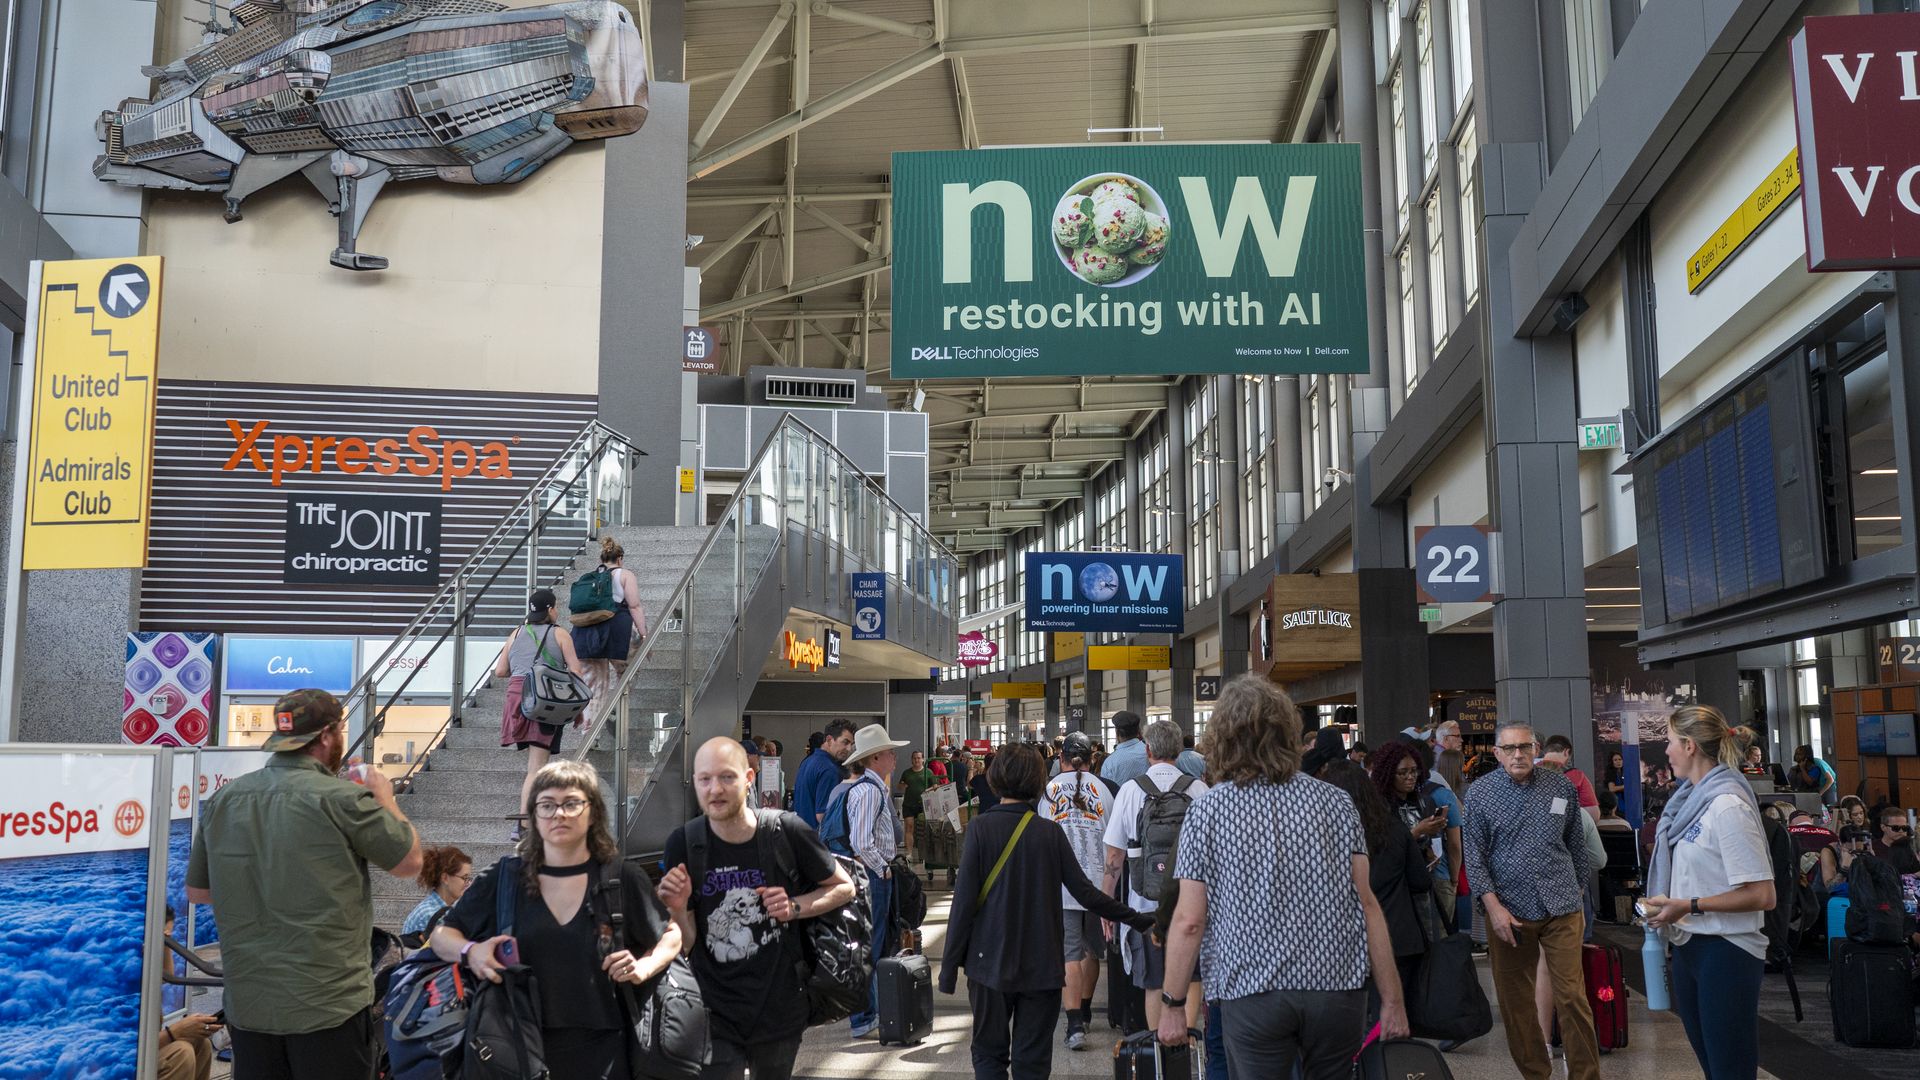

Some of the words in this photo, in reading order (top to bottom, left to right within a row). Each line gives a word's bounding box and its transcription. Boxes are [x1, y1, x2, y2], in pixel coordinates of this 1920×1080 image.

[1757, 188, 1774, 212] Gates
[1774, 177, 1782, 196] 23
[1785, 164, 1794, 184] 34
[1701, 249, 1715, 269] Gates
[1721, 233, 1728, 250] 22
[943, 293, 1163, 336] restocking
[1178, 291, 1264, 326] with
[1279, 292, 1321, 325] AI
[1235, 347, 1272, 356] Welcome
[1273, 347, 1282, 356] to
[1283, 347, 1302, 356] Now
[1315, 346, 1350, 356] Dell.com
[52, 372, 120, 399] United
[65, 406, 112, 432] Club
[1585, 424, 1617, 447] EXIT
[222, 419, 513, 491] XpresSpa
[39, 455, 131, 483] Admirals
[64, 490, 112, 516] Club
[296, 502, 337, 525] THE
[330, 509, 431, 551] JOINT
[291, 552, 428, 574] chiropractic
[1427, 545, 1480, 583] 22
[853, 590, 883, 598] MASSAGE
[859, 580, 878, 588] CHAIR
[1041, 603, 1090, 616] powering
[1092, 603, 1119, 614] lunar
[1121, 604, 1169, 615] missions
[1282, 610, 1317, 630] SALT
[1318, 610, 1352, 629] LICK
[388, 655, 429, 669] essie
[788, 631, 824, 672] XpresSpa
[1880, 645, 1893, 666] 22
[1900, 644, 1920, 664] 2
[267, 655, 313, 675] Calm
[1200, 681, 1217, 695] 21
[1072, 708, 1084, 718] 20
[1459, 712, 1478, 721] Beer
[1472, 722, 1481, 731] To
[1483, 722, 1495, 730] Go
